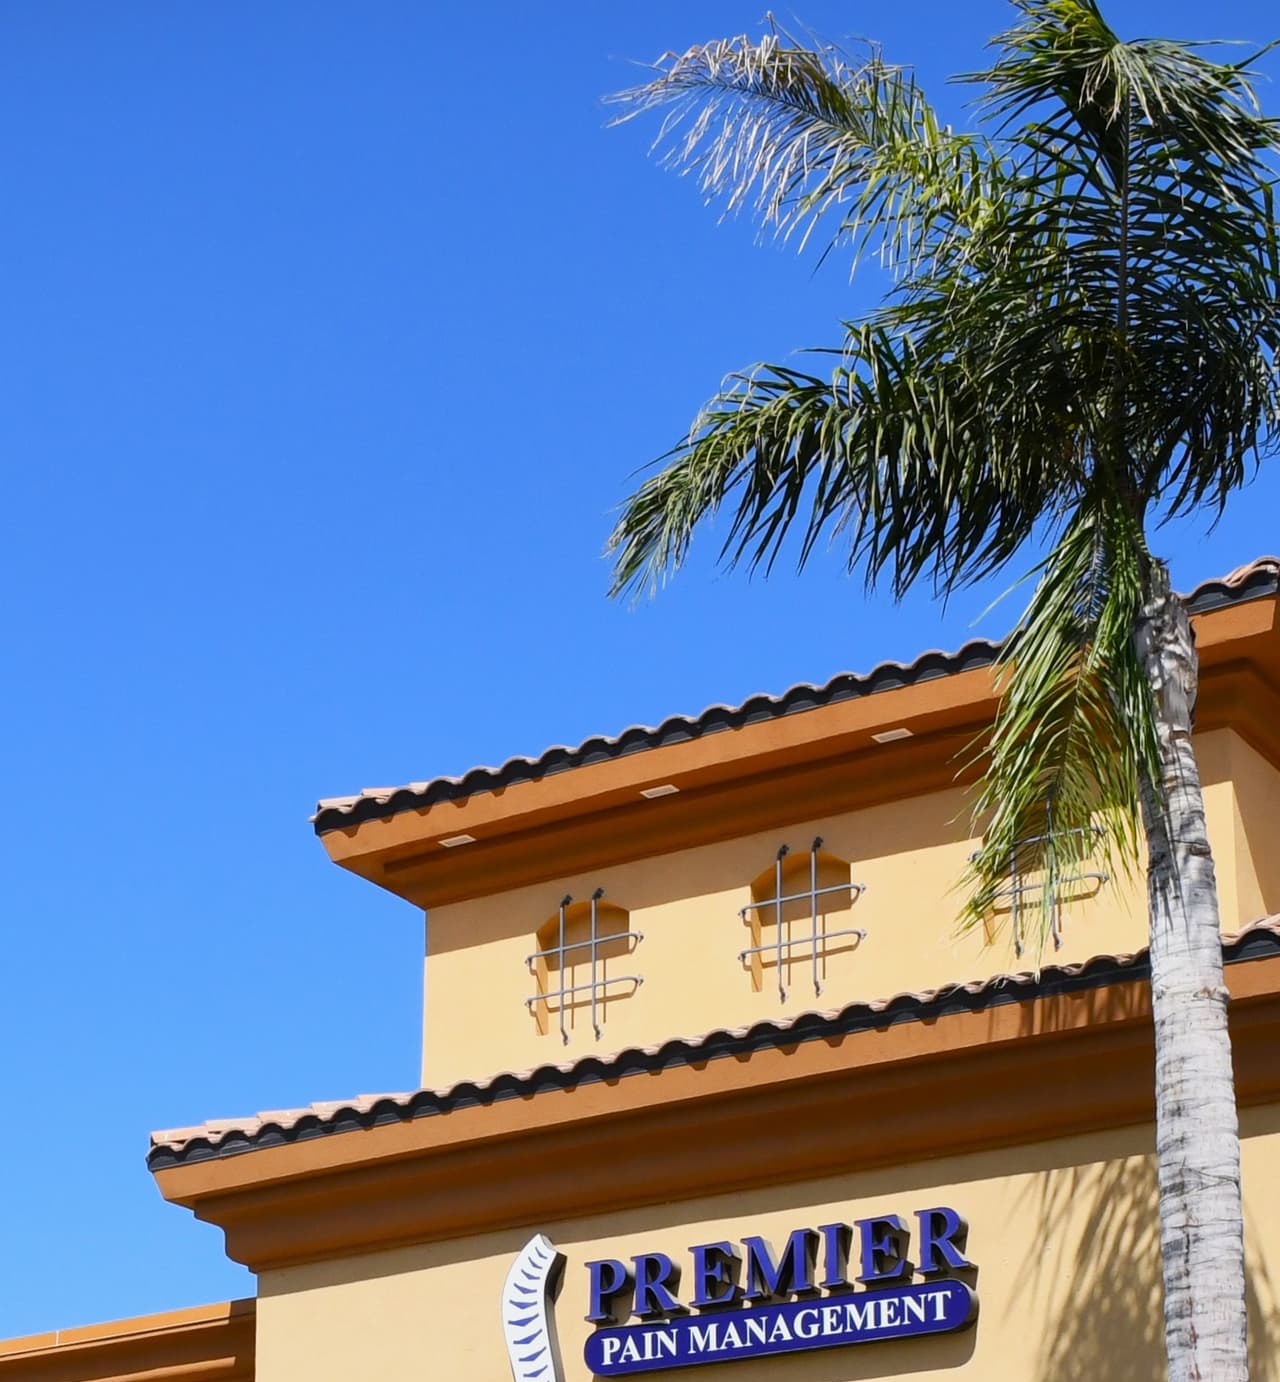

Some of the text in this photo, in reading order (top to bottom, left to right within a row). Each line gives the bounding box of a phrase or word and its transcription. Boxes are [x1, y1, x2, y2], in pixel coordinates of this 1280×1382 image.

[584, 1206, 970, 1322] PREMIER
[600, 1290, 952, 1366] PAIN MANAGEMENT
